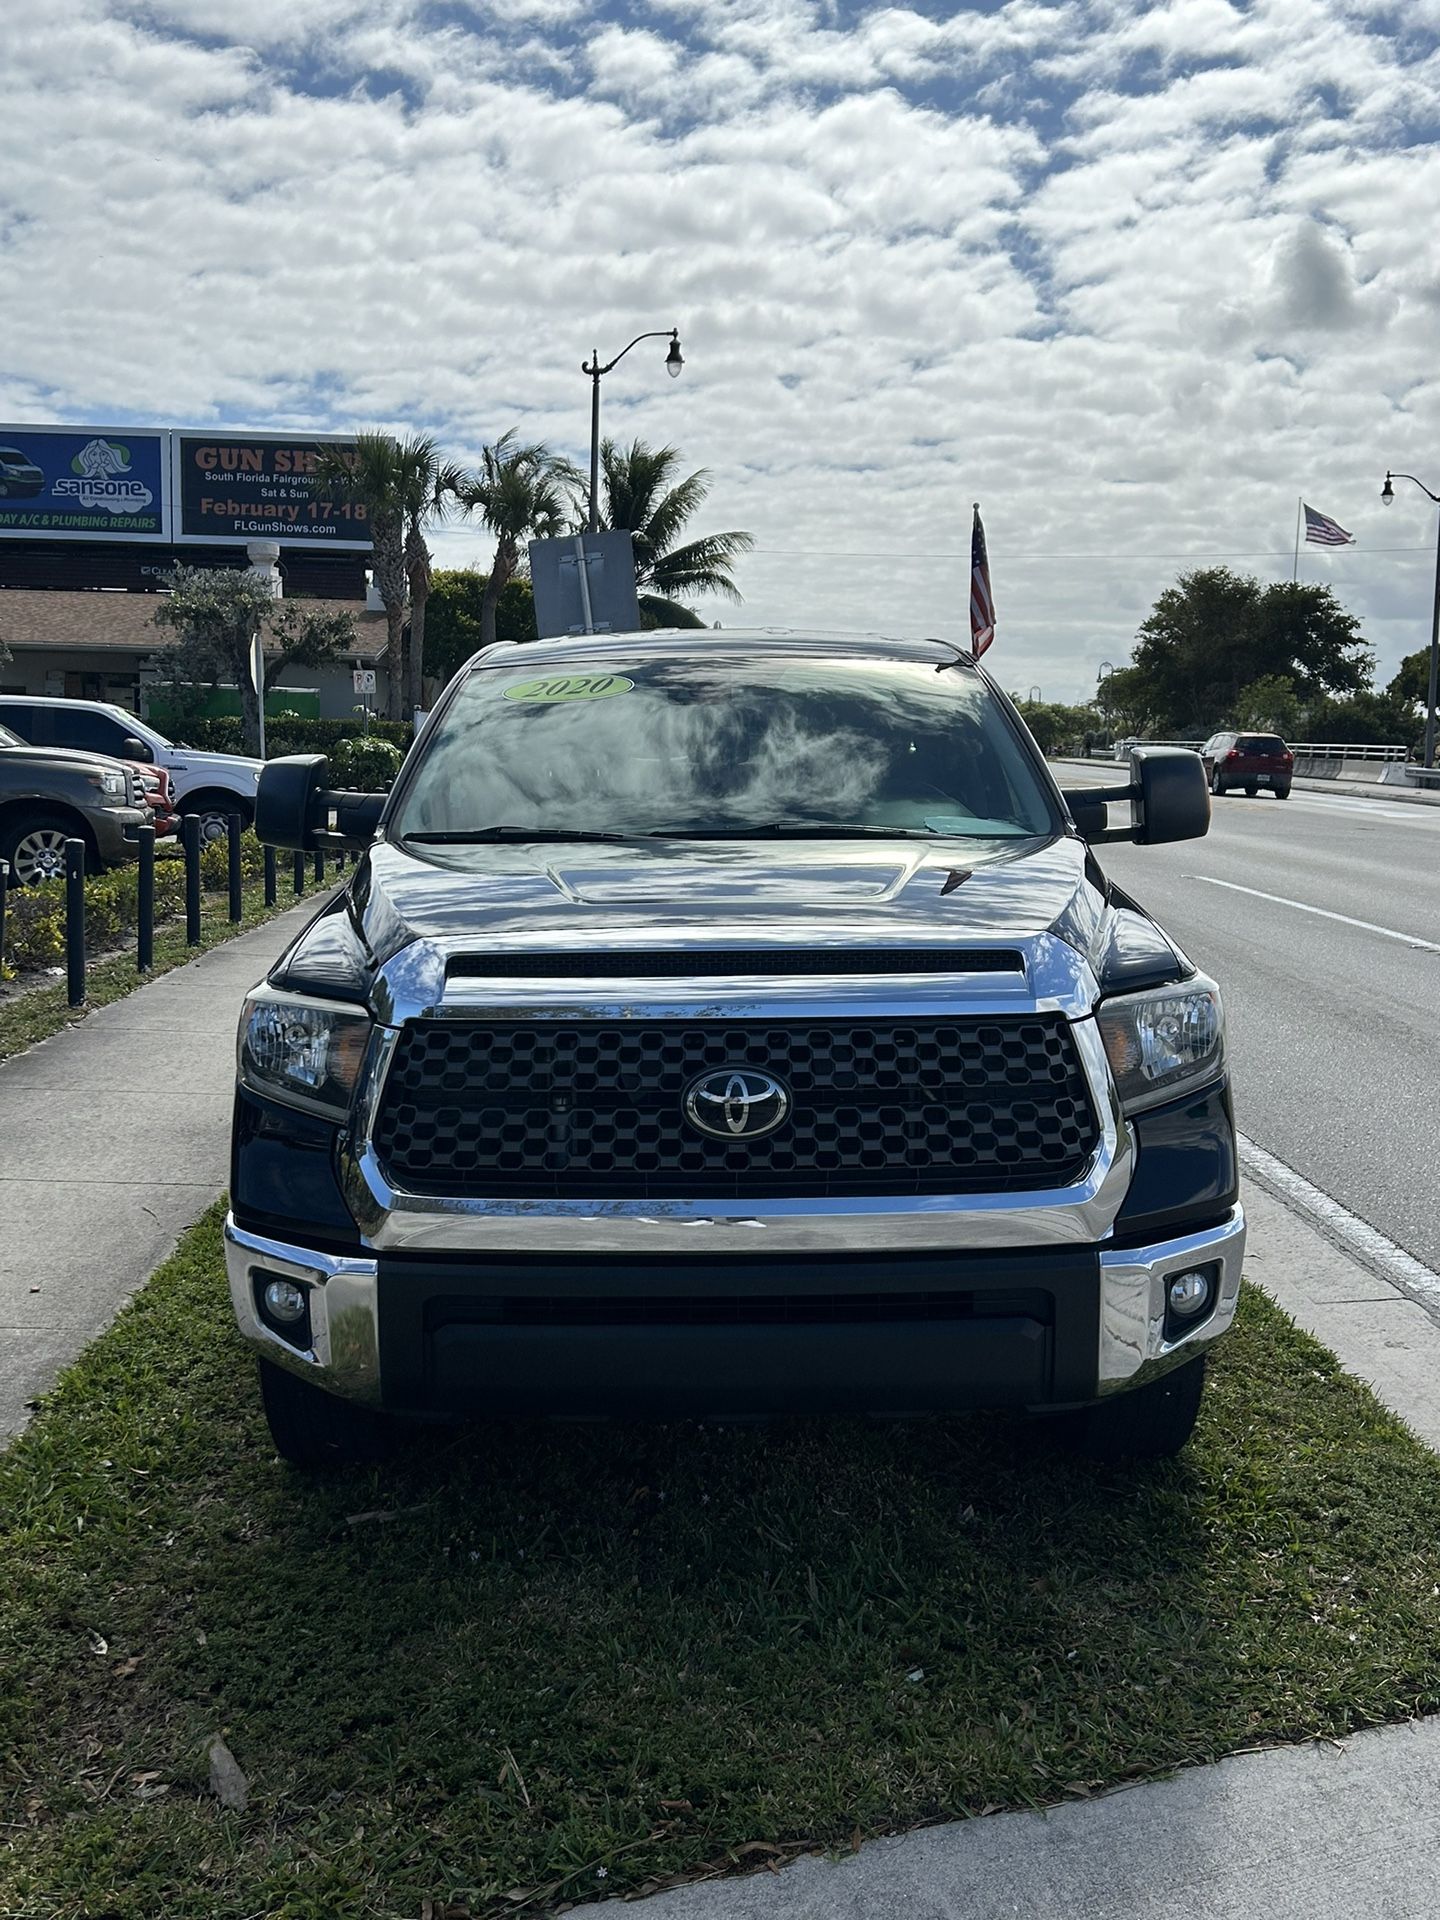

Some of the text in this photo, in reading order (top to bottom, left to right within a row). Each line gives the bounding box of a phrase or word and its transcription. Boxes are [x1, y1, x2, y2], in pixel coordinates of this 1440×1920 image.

[195, 447, 264, 471] GUN
[205, 472, 234, 481] South
[236, 473, 270, 483] Florida
[53, 479, 147, 497] sansone
[261, 488, 309, 498] Sat & Sun
[201, 498, 367, 521] February 17-18
[19, 514, 40, 526] A/C
[42, 514, 49, 525] &
[51, 515, 108, 528] PLUMBING
[109, 517, 156, 529] REPAIRS
[234, 520, 336, 534] FLGunShows.com
[522, 677, 614, 697] 2020
